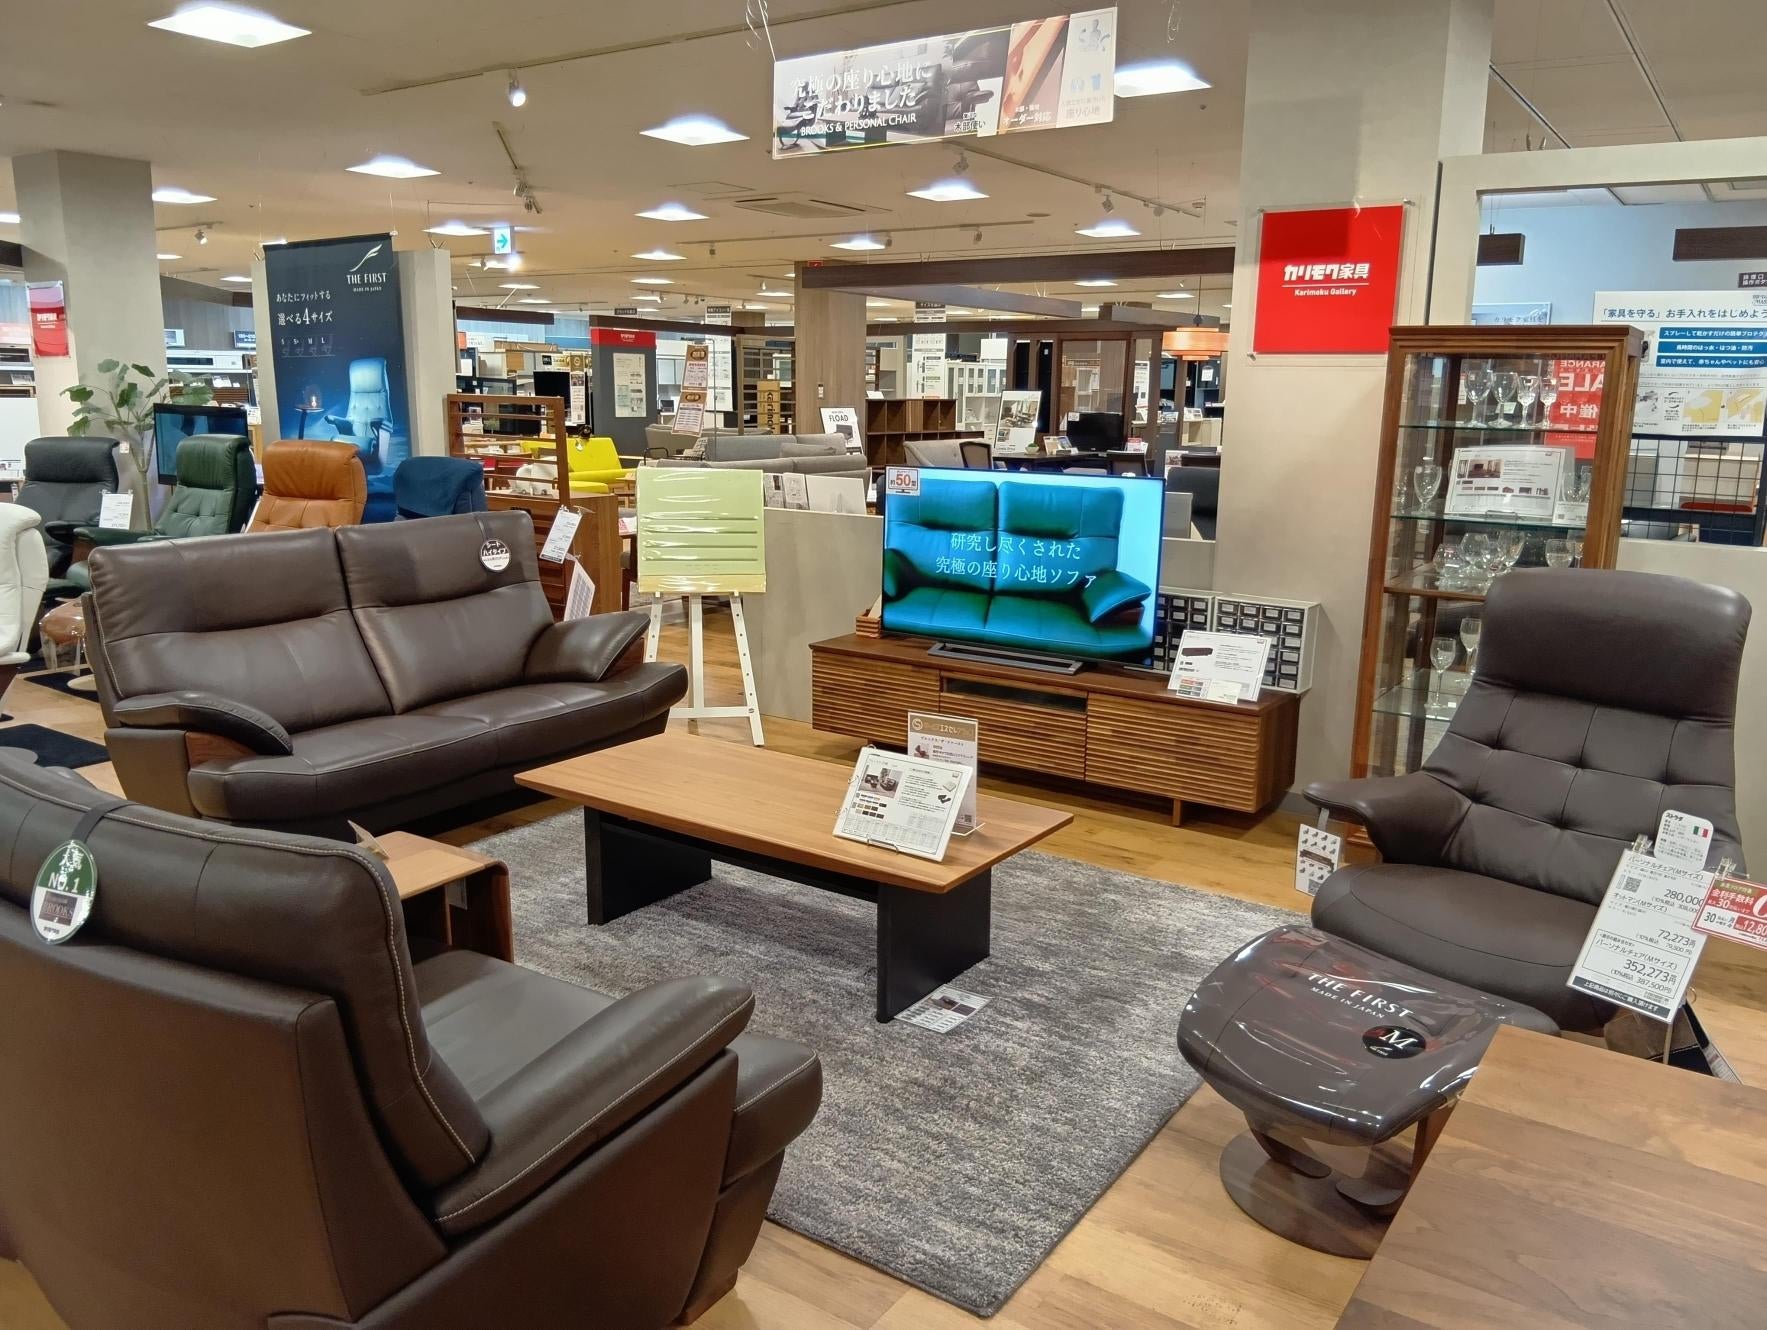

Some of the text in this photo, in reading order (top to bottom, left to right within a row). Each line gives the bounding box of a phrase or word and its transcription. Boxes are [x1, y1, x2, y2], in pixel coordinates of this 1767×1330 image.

[793, 86, 919, 119] こだわりました
[800, 113, 917, 136] BROOKS & PERSONAL CHAIR
[346, 272, 387, 285] THE FIRST
[1283, 263, 1370, 281] カリモク家具
[276, 290, 331, 303] あなたにフィットする
[1294, 288, 1357, 297] Karimoku Gallery
[277, 307, 333, 326] 選べる4サイズ
[951, 533, 1081, 560] 研究し尽くされた
[936, 556, 1097, 589] 究極の座り心地ソファ
[1596, 939, 1678, 970] パーソナルチェア(Mサイズ)
[1308, 973, 1414, 1018] THE FIRST
[1310, 986, 1384, 1018] MADE IN JAPAN
[1379, 1030, 1418, 1049] M
